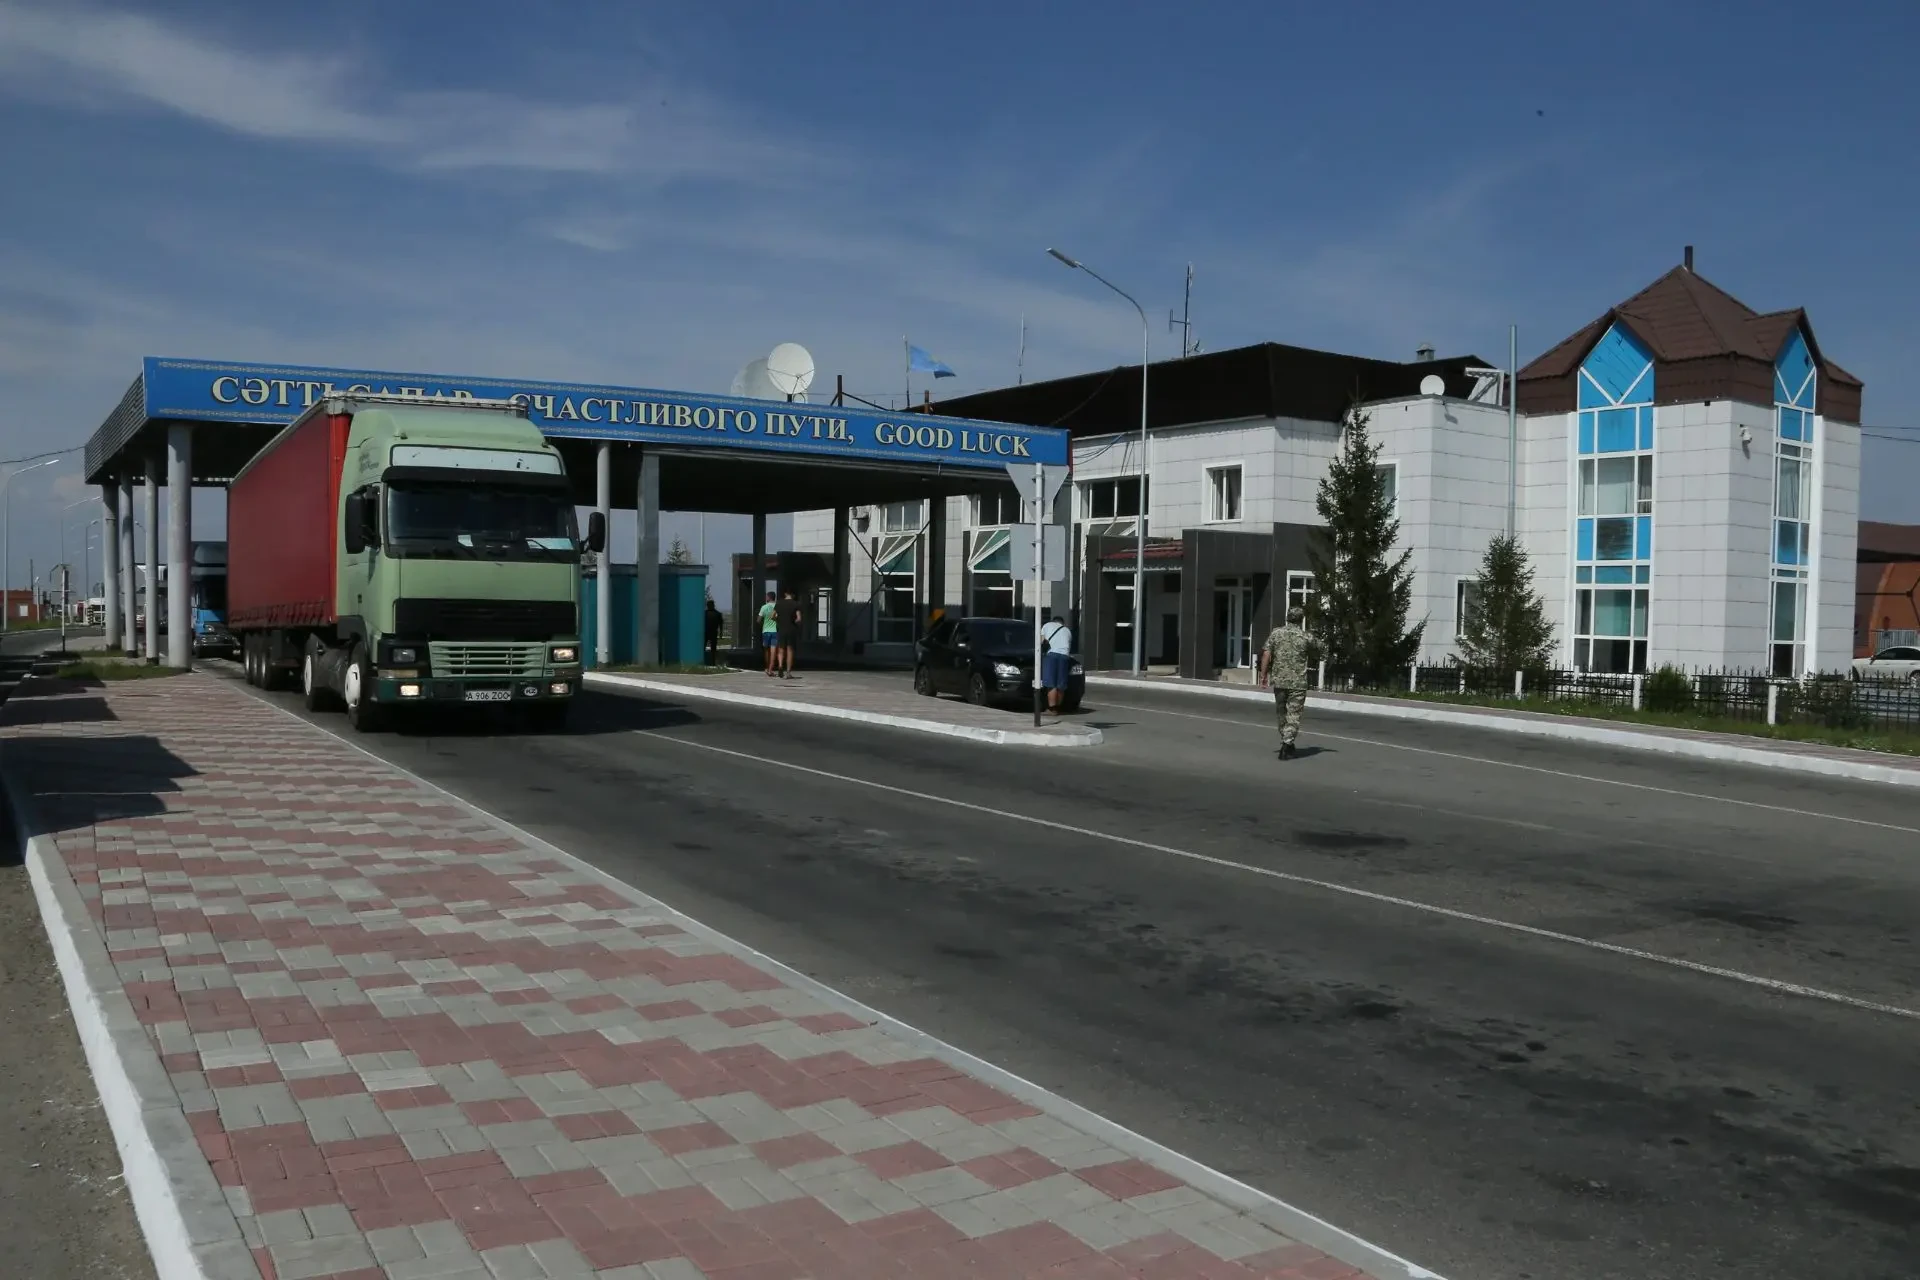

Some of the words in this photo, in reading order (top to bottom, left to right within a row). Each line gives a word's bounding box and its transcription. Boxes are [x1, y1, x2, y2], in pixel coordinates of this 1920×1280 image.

[764, 412, 855, 445] ПУТИ,
[875, 422, 954, 449] GOOD
[960, 430, 1031, 457] LUCK
[475, 692, 490, 700] 906
